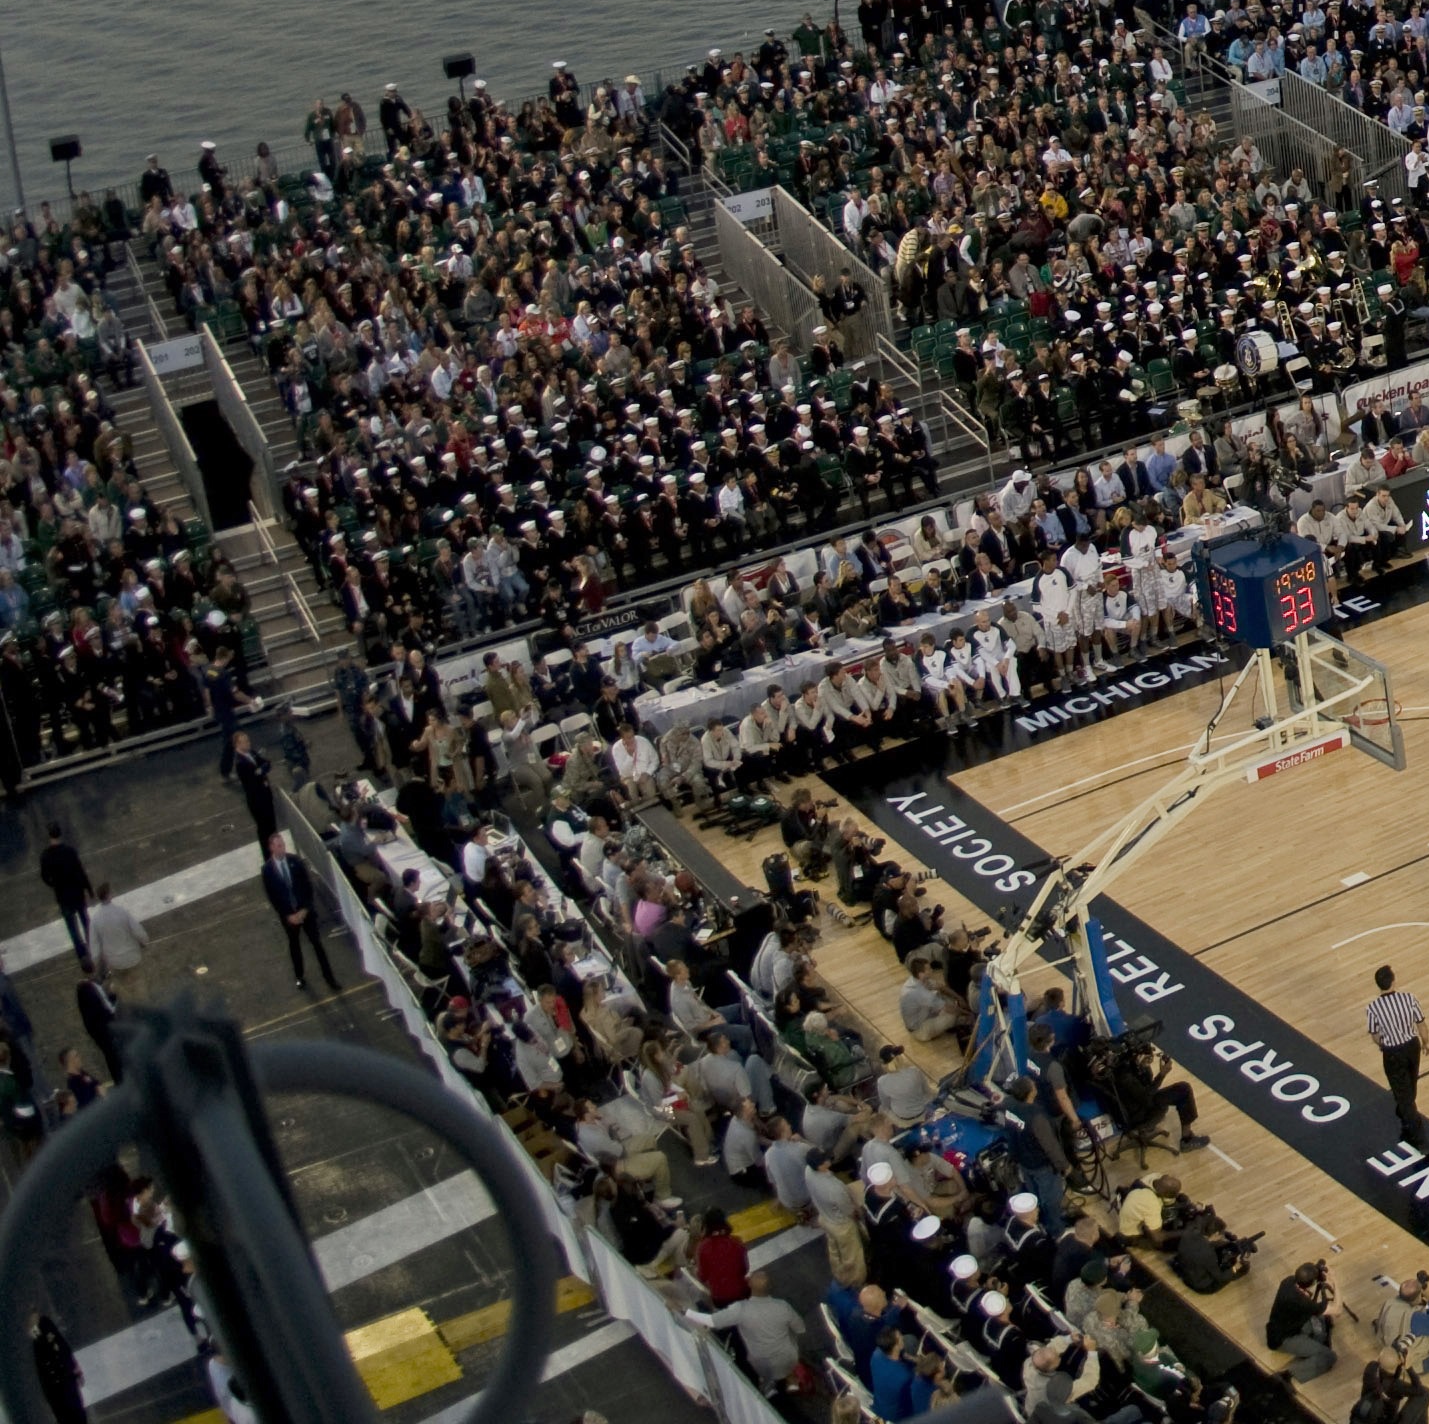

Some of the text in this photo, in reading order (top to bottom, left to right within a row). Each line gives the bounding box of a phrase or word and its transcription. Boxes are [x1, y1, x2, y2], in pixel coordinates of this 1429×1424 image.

[755, 197, 770, 208] 203
[1276, 561, 1316, 595] 19:48
[601, 610, 639, 628] VALOR
[1280, 586, 1316, 633] 33
[1014, 651, 1232, 733] MICHIGAN
[886, 791, 1037, 893] SOCIETY
[1187, 1013, 1352, 1124] CORPS
